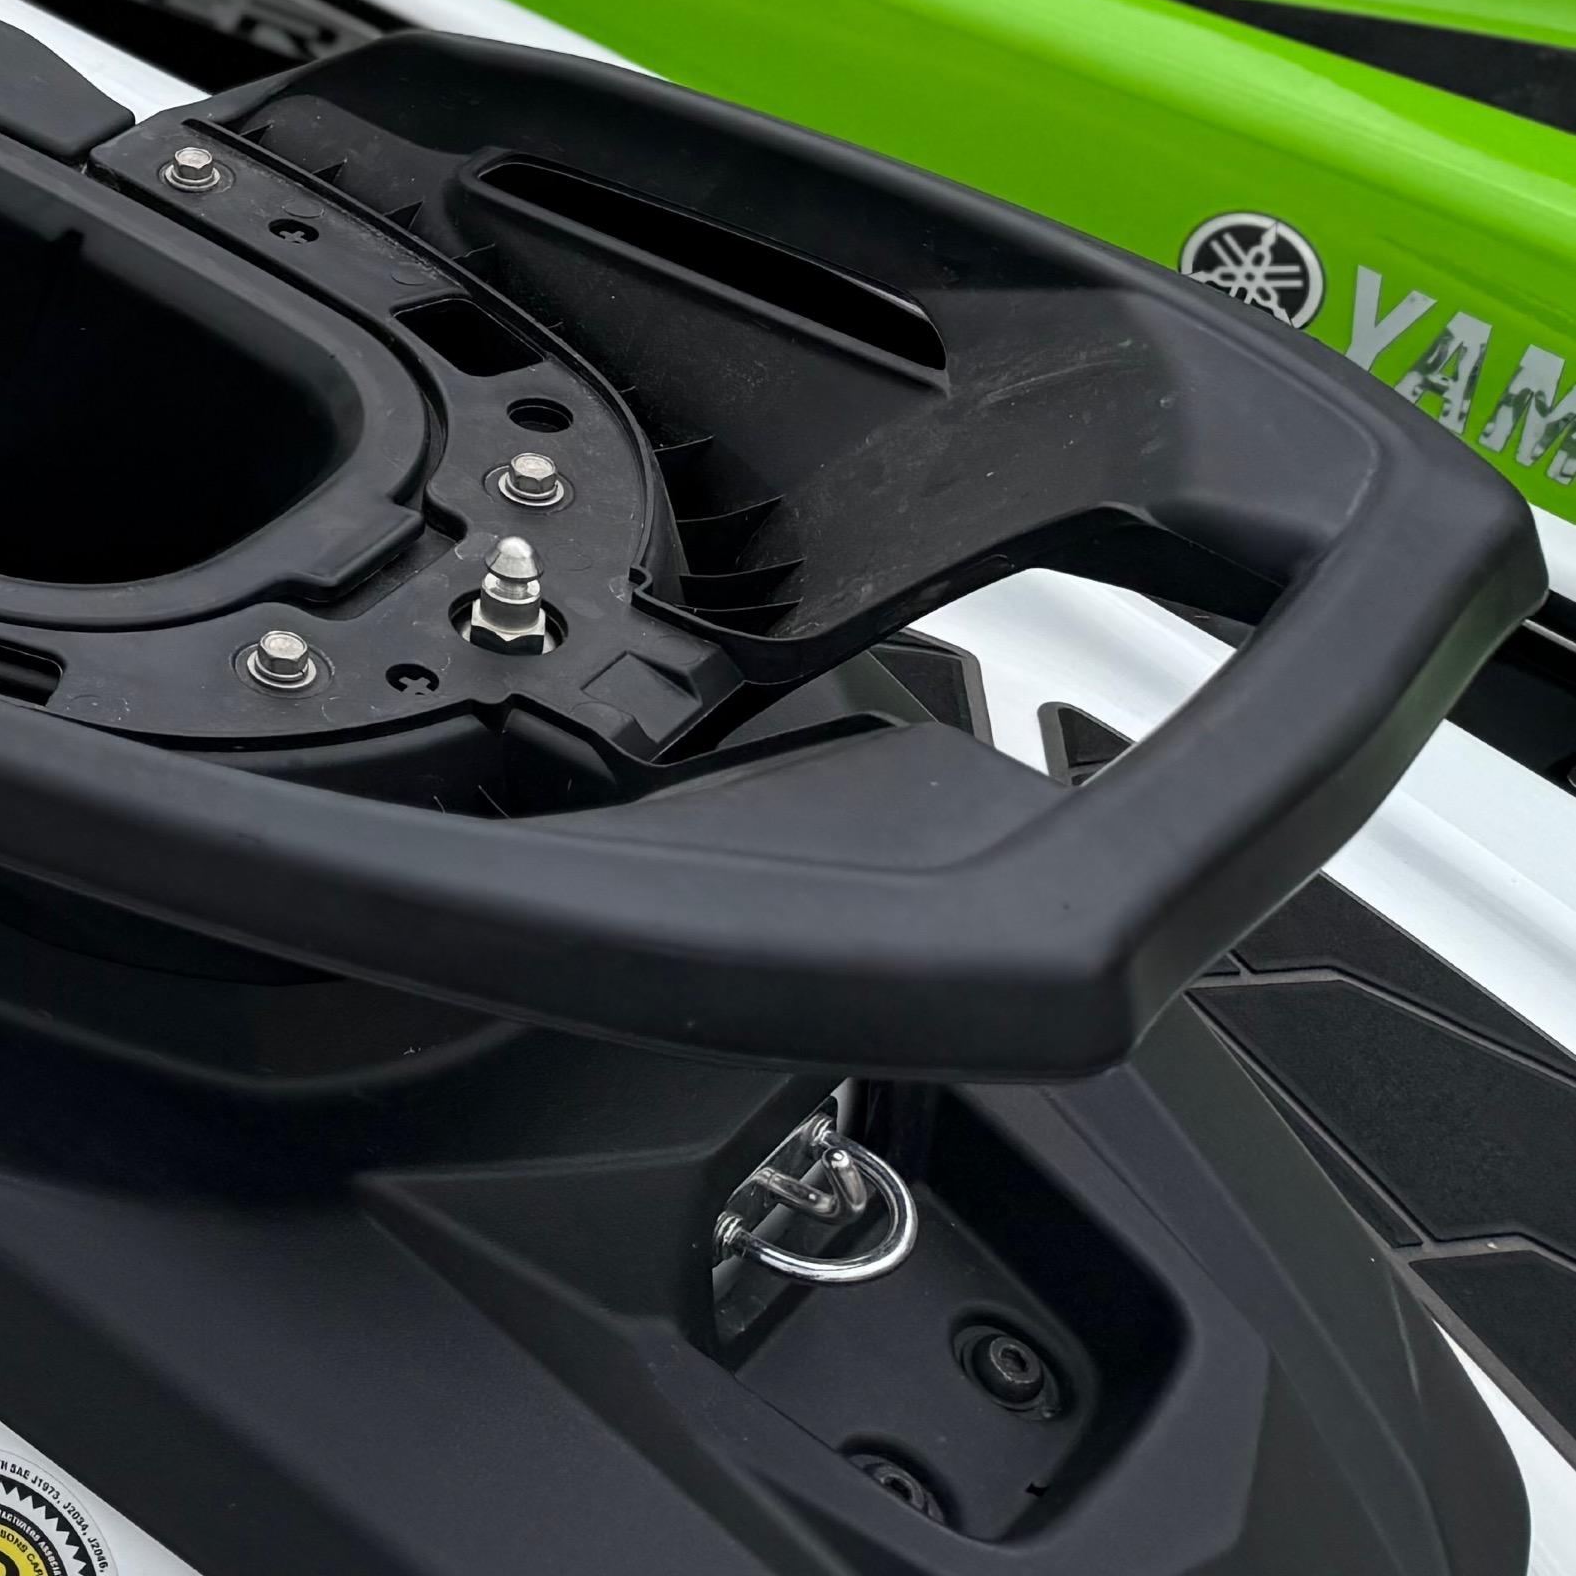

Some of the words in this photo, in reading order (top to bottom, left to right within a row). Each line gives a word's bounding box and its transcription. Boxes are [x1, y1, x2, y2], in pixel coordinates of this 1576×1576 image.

[9, 1463, 30, 1479] SAE
[31, 1475, 61, 1504] J1973,
[62, 1502, 89, 1536] J2034,
